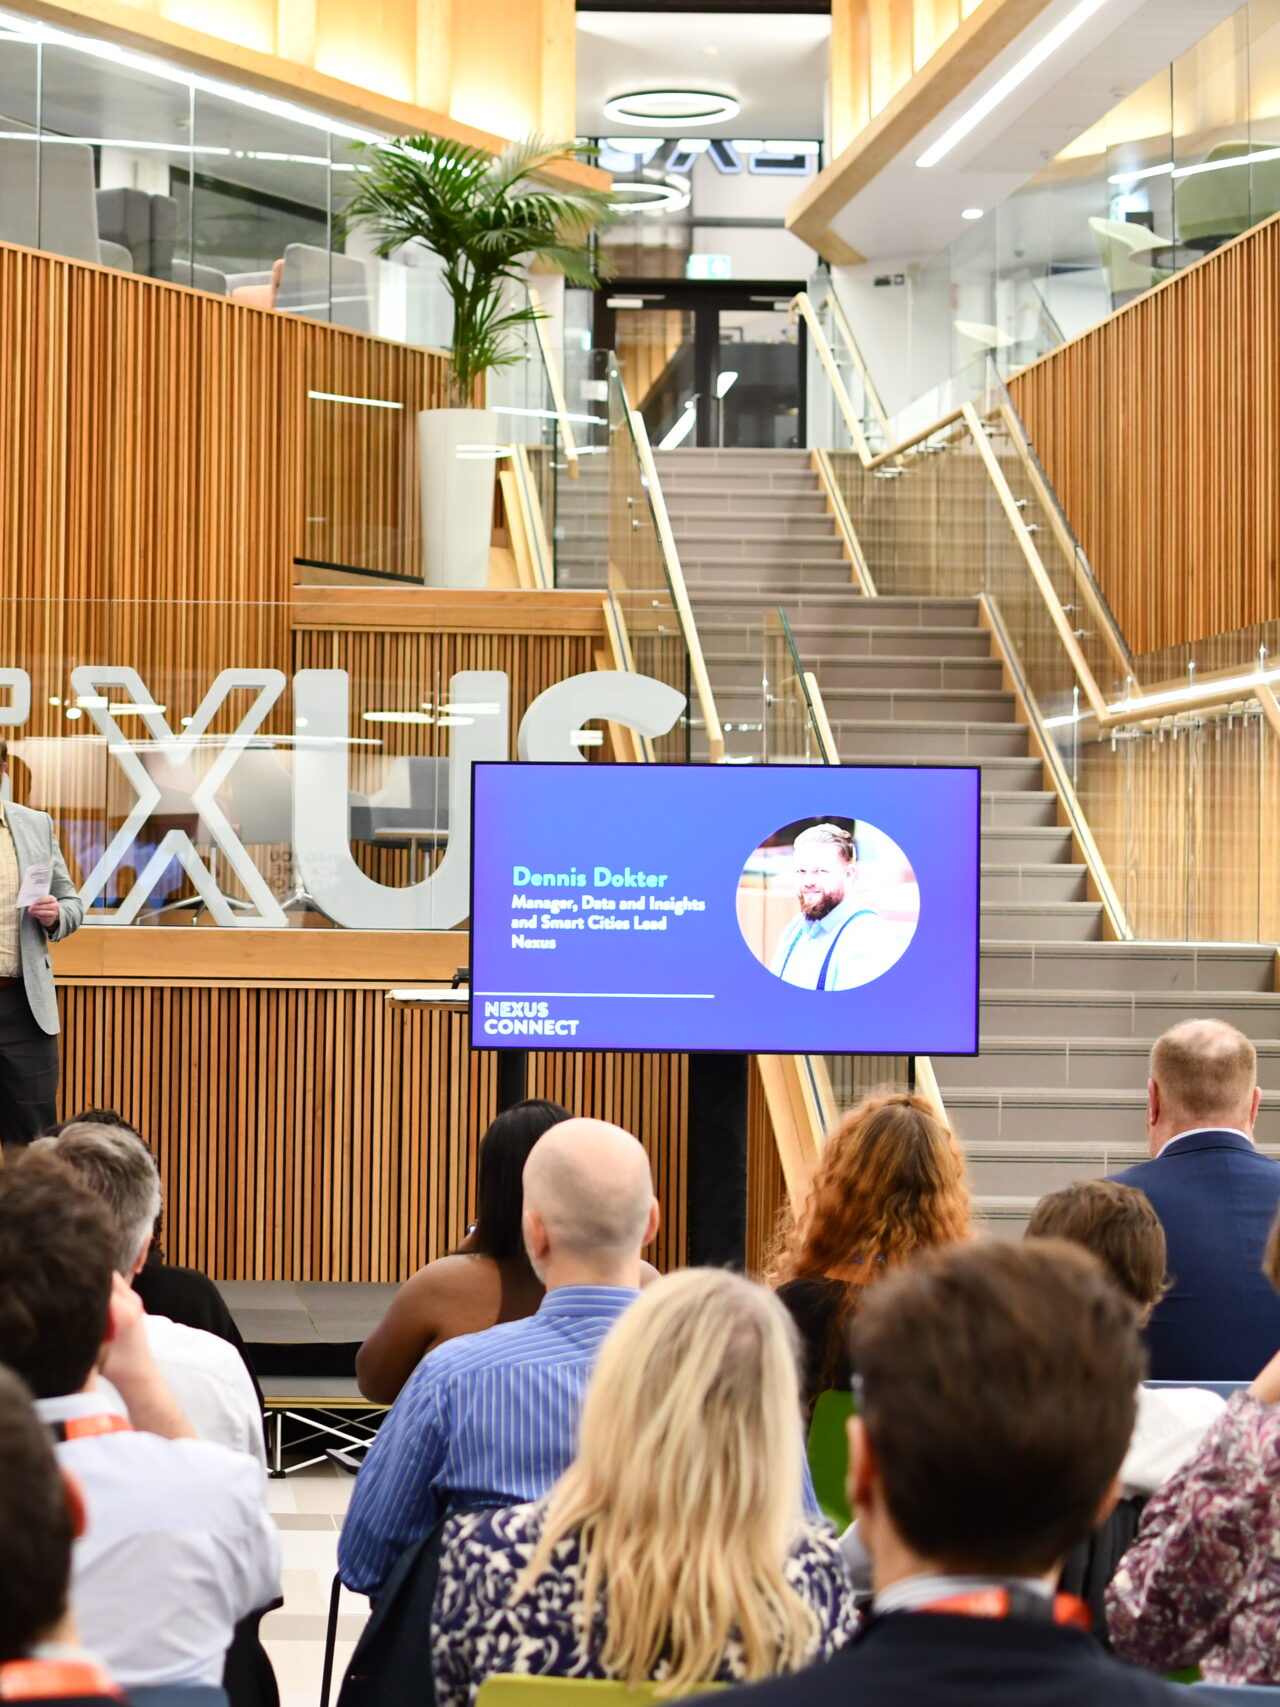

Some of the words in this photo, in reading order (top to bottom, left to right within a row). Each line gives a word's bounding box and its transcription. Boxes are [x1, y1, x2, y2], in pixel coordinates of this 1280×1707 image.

[513, 866, 587, 887] Dennis
[594, 867, 668, 888] Dokter
[511, 894, 578, 913] Manager,
[582, 895, 616, 910] Data
[619, 896, 646, 910] and
[649, 896, 706, 917] Insights
[511, 914, 537, 929] and
[541, 915, 585, 930] Smart
[587, 915, 630, 930] Cities
[634, 915, 667, 930] Lead
[512, 934, 556, 949] Nexus
[485, 1001, 549, 1018] NEXUS
[484, 1019, 579, 1035] CONNECT
